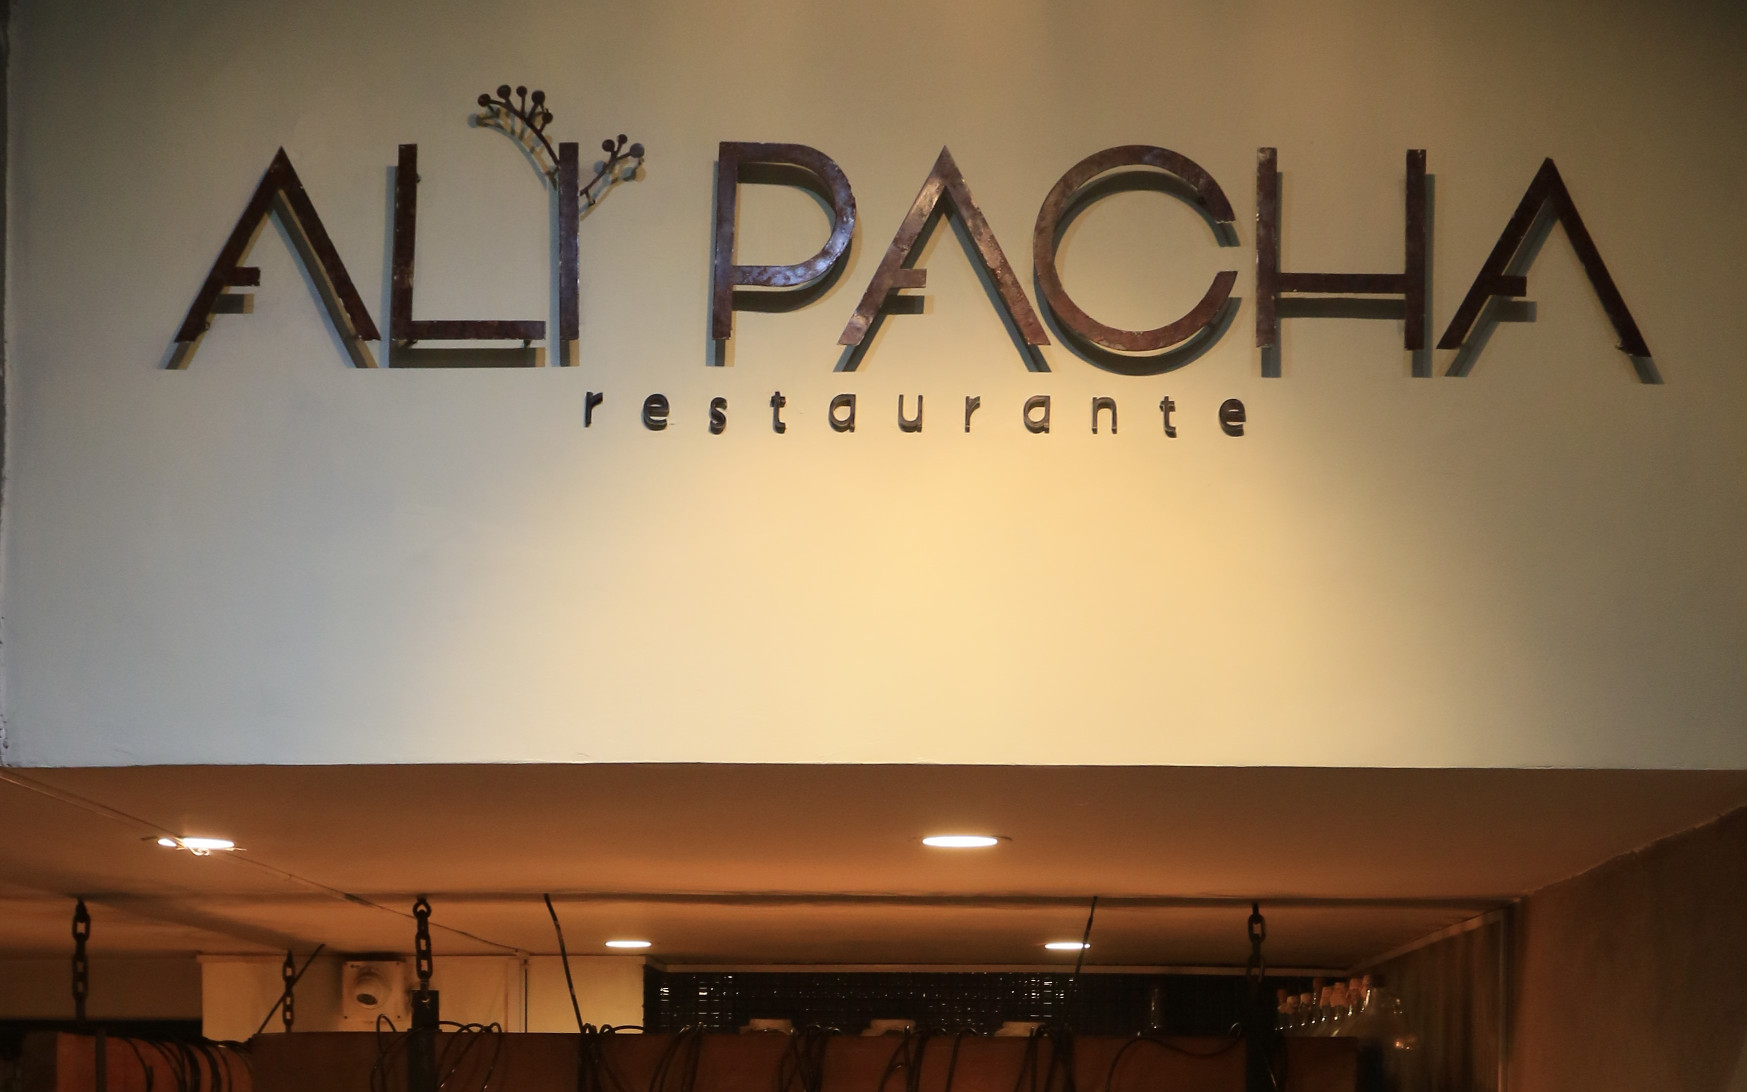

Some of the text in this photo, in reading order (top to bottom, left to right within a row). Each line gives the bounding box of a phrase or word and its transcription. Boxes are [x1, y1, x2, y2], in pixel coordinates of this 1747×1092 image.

[170, 138, 1652, 359] ALI PACHA
[583, 389, 1247, 438] restaurante
